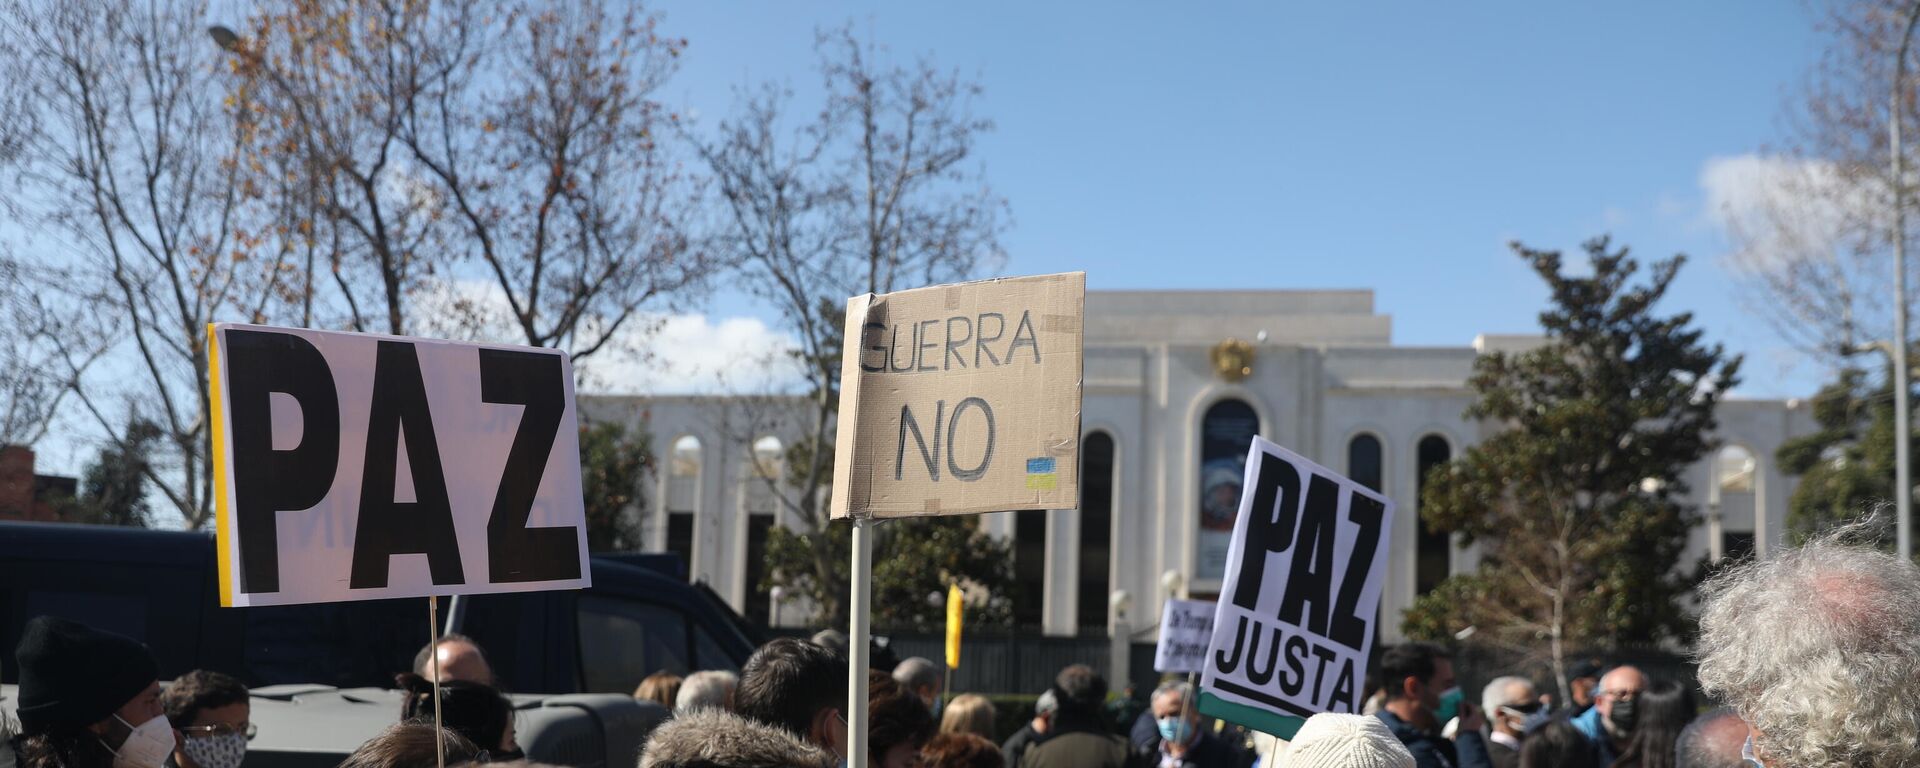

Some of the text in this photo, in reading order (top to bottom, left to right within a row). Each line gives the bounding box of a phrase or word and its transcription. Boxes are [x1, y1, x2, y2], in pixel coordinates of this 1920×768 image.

[859, 309, 1041, 373] GUERRA
[225, 329, 582, 594] PAZ
[894, 396, 996, 482] NO
[1232, 451, 1386, 651] PAZ
[1215, 615, 1355, 714] JUSTA
